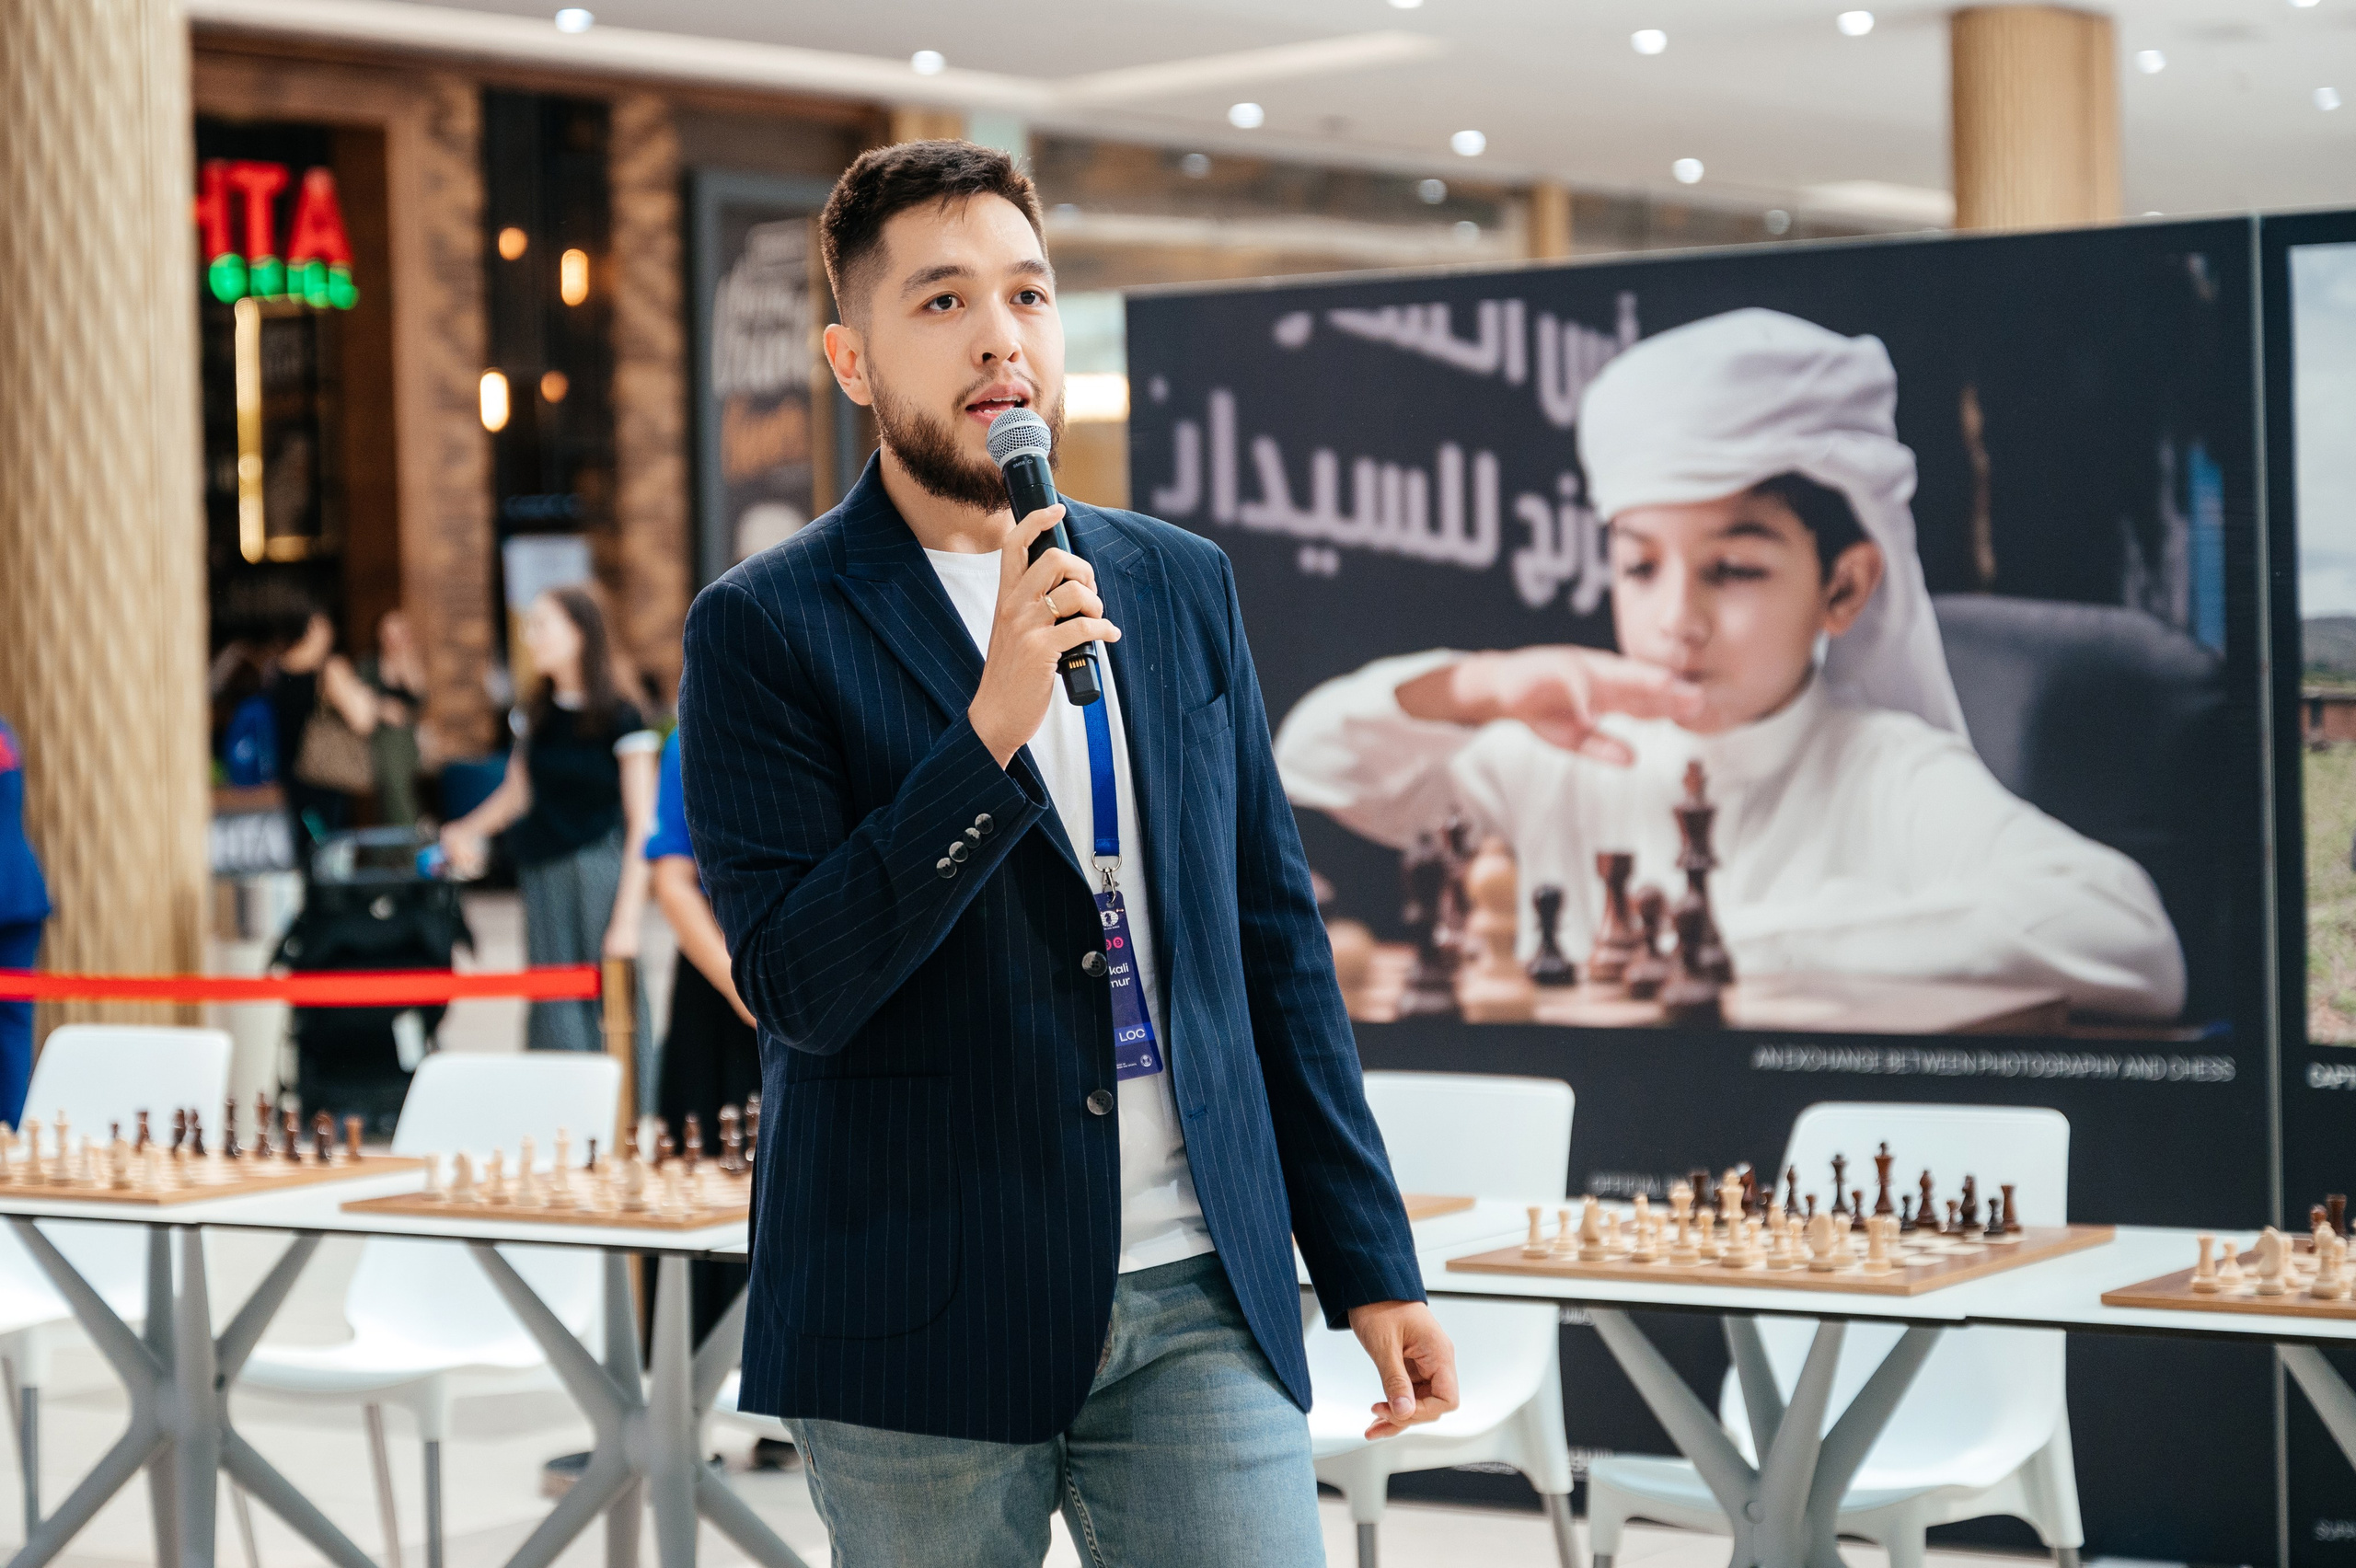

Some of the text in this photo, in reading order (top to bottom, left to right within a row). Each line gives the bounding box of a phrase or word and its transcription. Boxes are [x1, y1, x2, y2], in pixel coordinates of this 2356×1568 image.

[1118, 1028, 1146, 1042] LOC
[1785, 1045, 1882, 1074] EXCHANGE
[1884, 1047, 1977, 1076] BETWEEN
[1978, 1049, 2121, 1078] PHOTOGRAPHY
[2120, 1054, 2167, 1081] AND
[2166, 1055, 2236, 1082] CHESS
